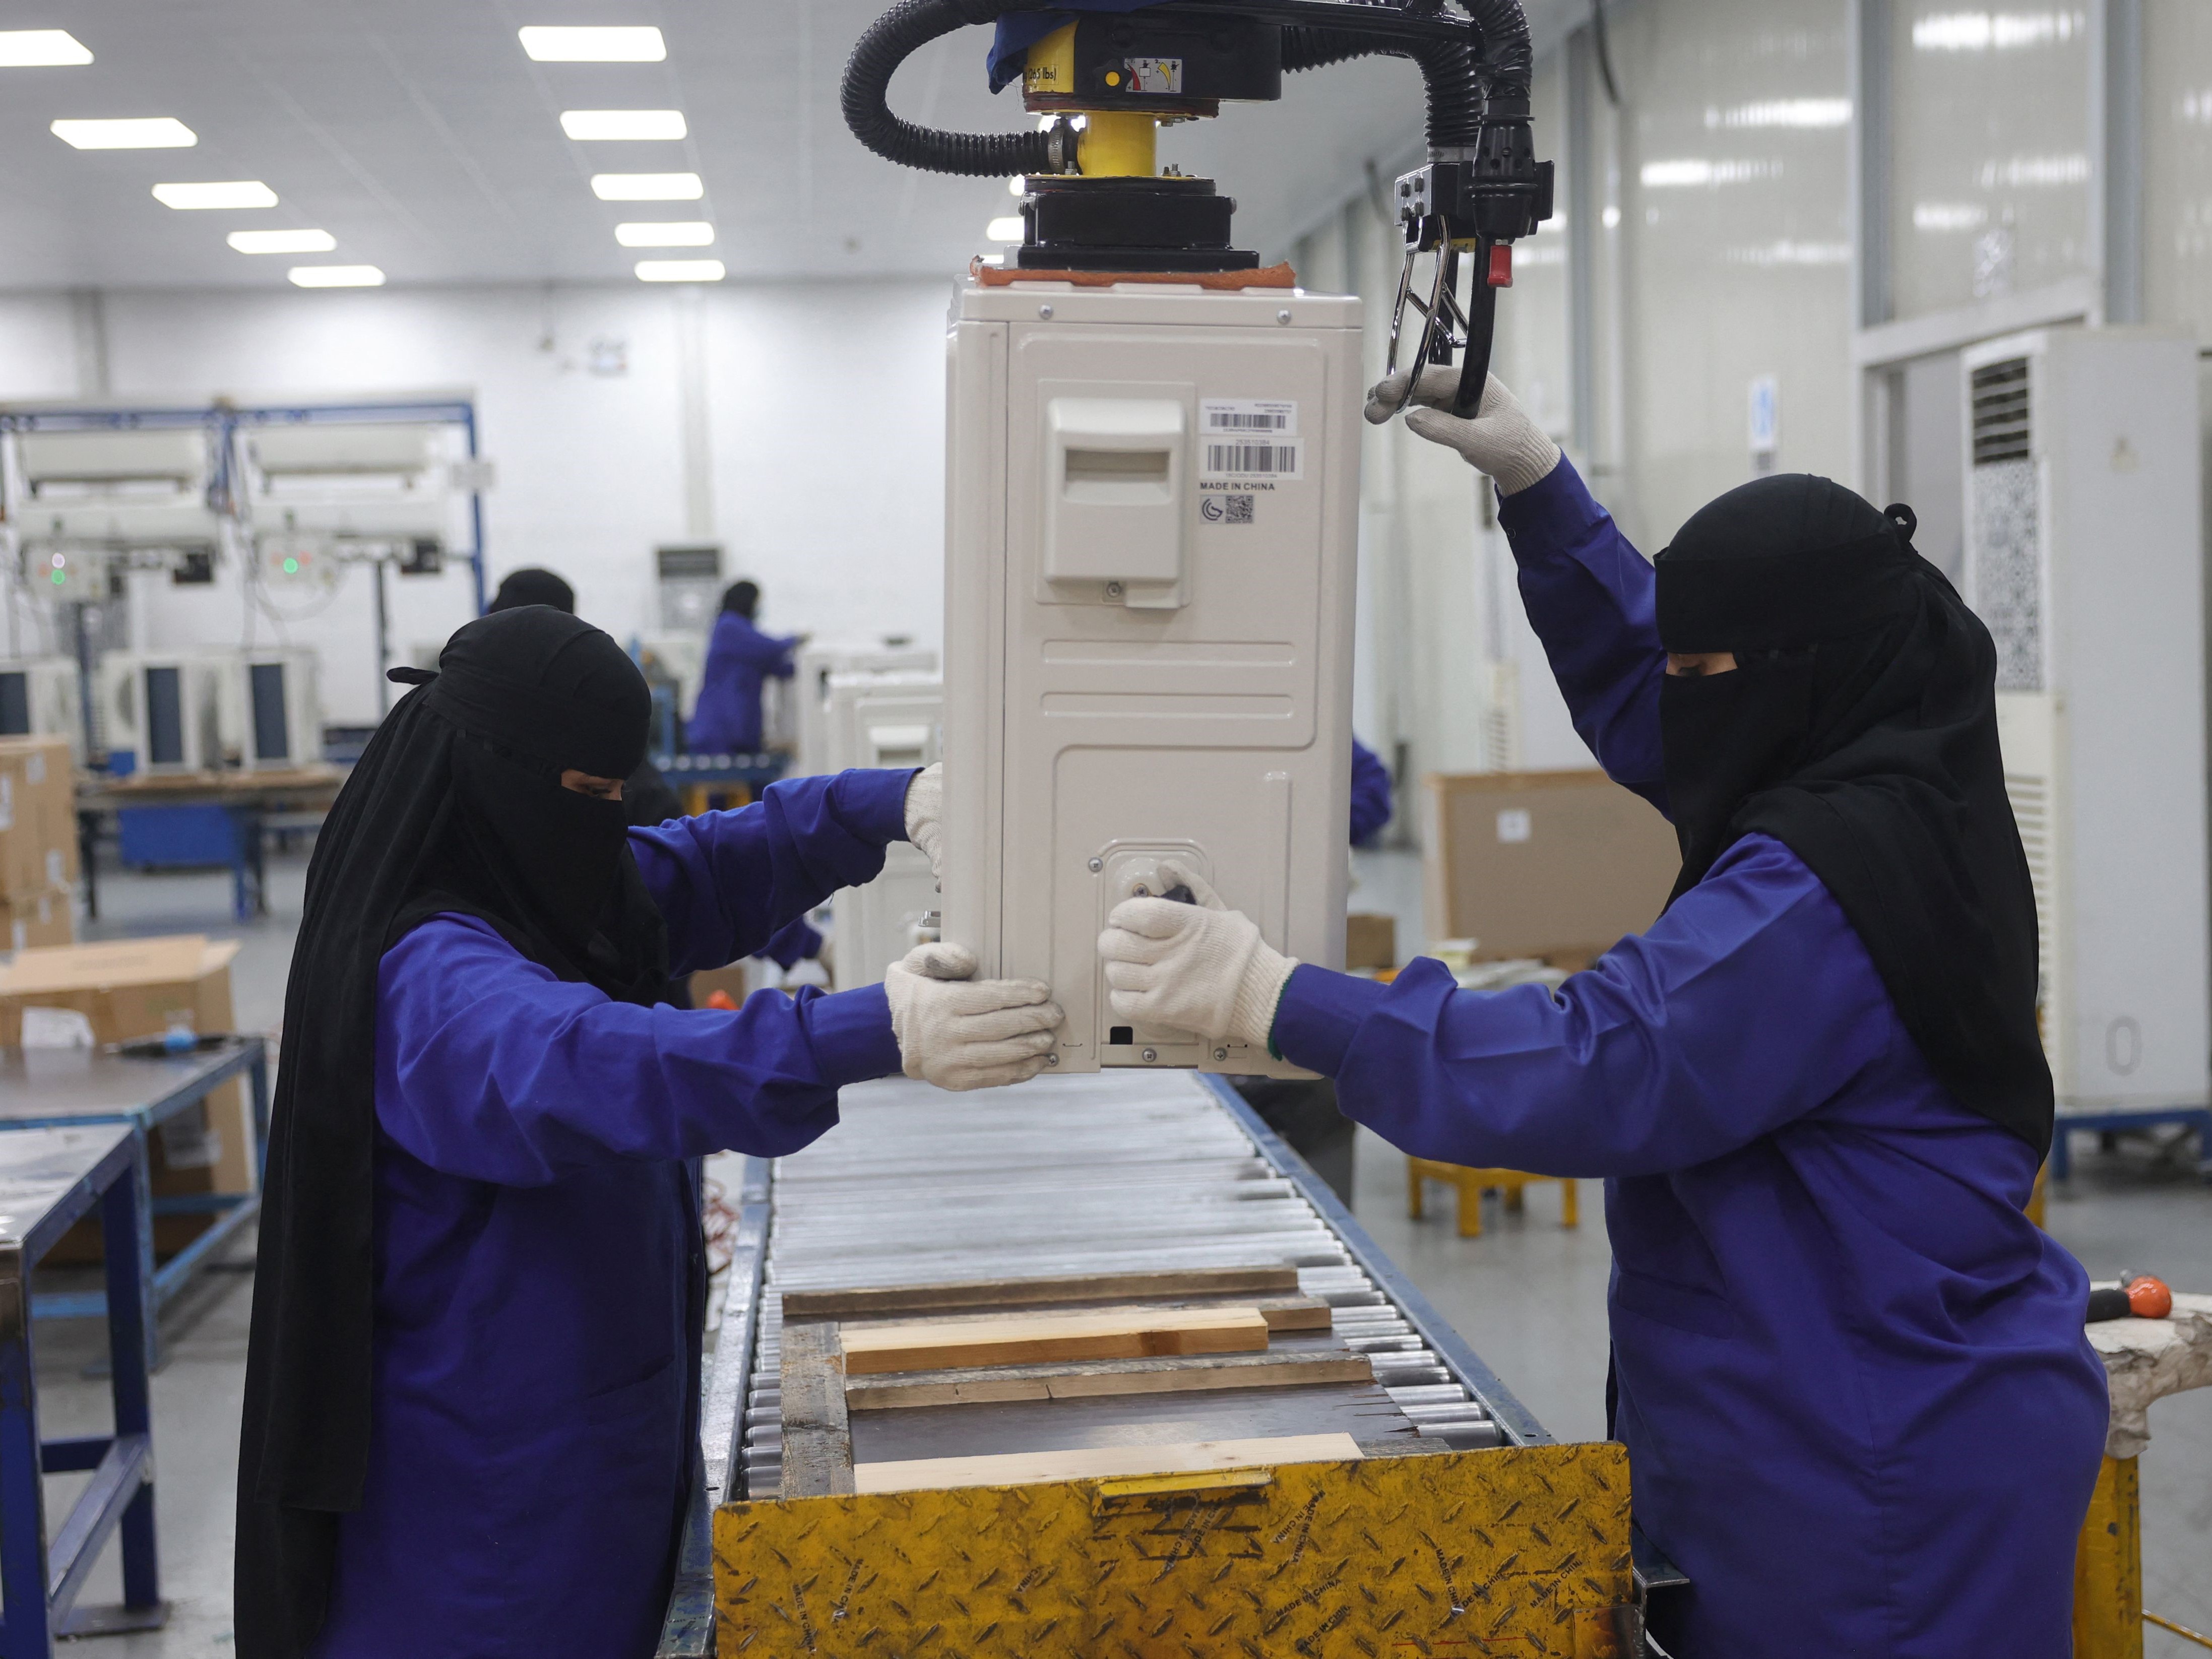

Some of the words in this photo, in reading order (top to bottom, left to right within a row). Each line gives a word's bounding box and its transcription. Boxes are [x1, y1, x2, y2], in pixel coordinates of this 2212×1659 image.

[1043, 67, 1056, 81] lbs)
[1199, 482, 1229, 490] MADE
[1231, 482, 1241, 490] IN
[1243, 483, 1276, 491] CHINA
[1203, 1520, 1211, 1529] IN
[1295, 1511, 1305, 1521] IN
[1302, 1523, 1310, 1533] IN
[1273, 1520, 1296, 1544] CHINA
[1292, 1535, 1306, 1562] CHINA
[849, 1558, 864, 1583] MADE
[1436, 1548, 1449, 1575] MADE
[1444, 1575, 1452, 1585] IN
[844, 1584, 853, 1594] IN
[1017, 1569, 1038, 1592] CHINA
[792, 1583, 805, 1609] MADE
[1276, 1599, 1302, 1618] MADE
[1313, 1579, 1342, 1597] CHINA
[1530, 1586, 1553, 1609] MADE
[1551, 1578, 1561, 1588] IN
[800, 1611, 808, 1620] IN
[802, 1622, 815, 1652] CHINA
[1297, 1630, 1321, 1653] MADE
[1318, 1622, 1329, 1633] IN
